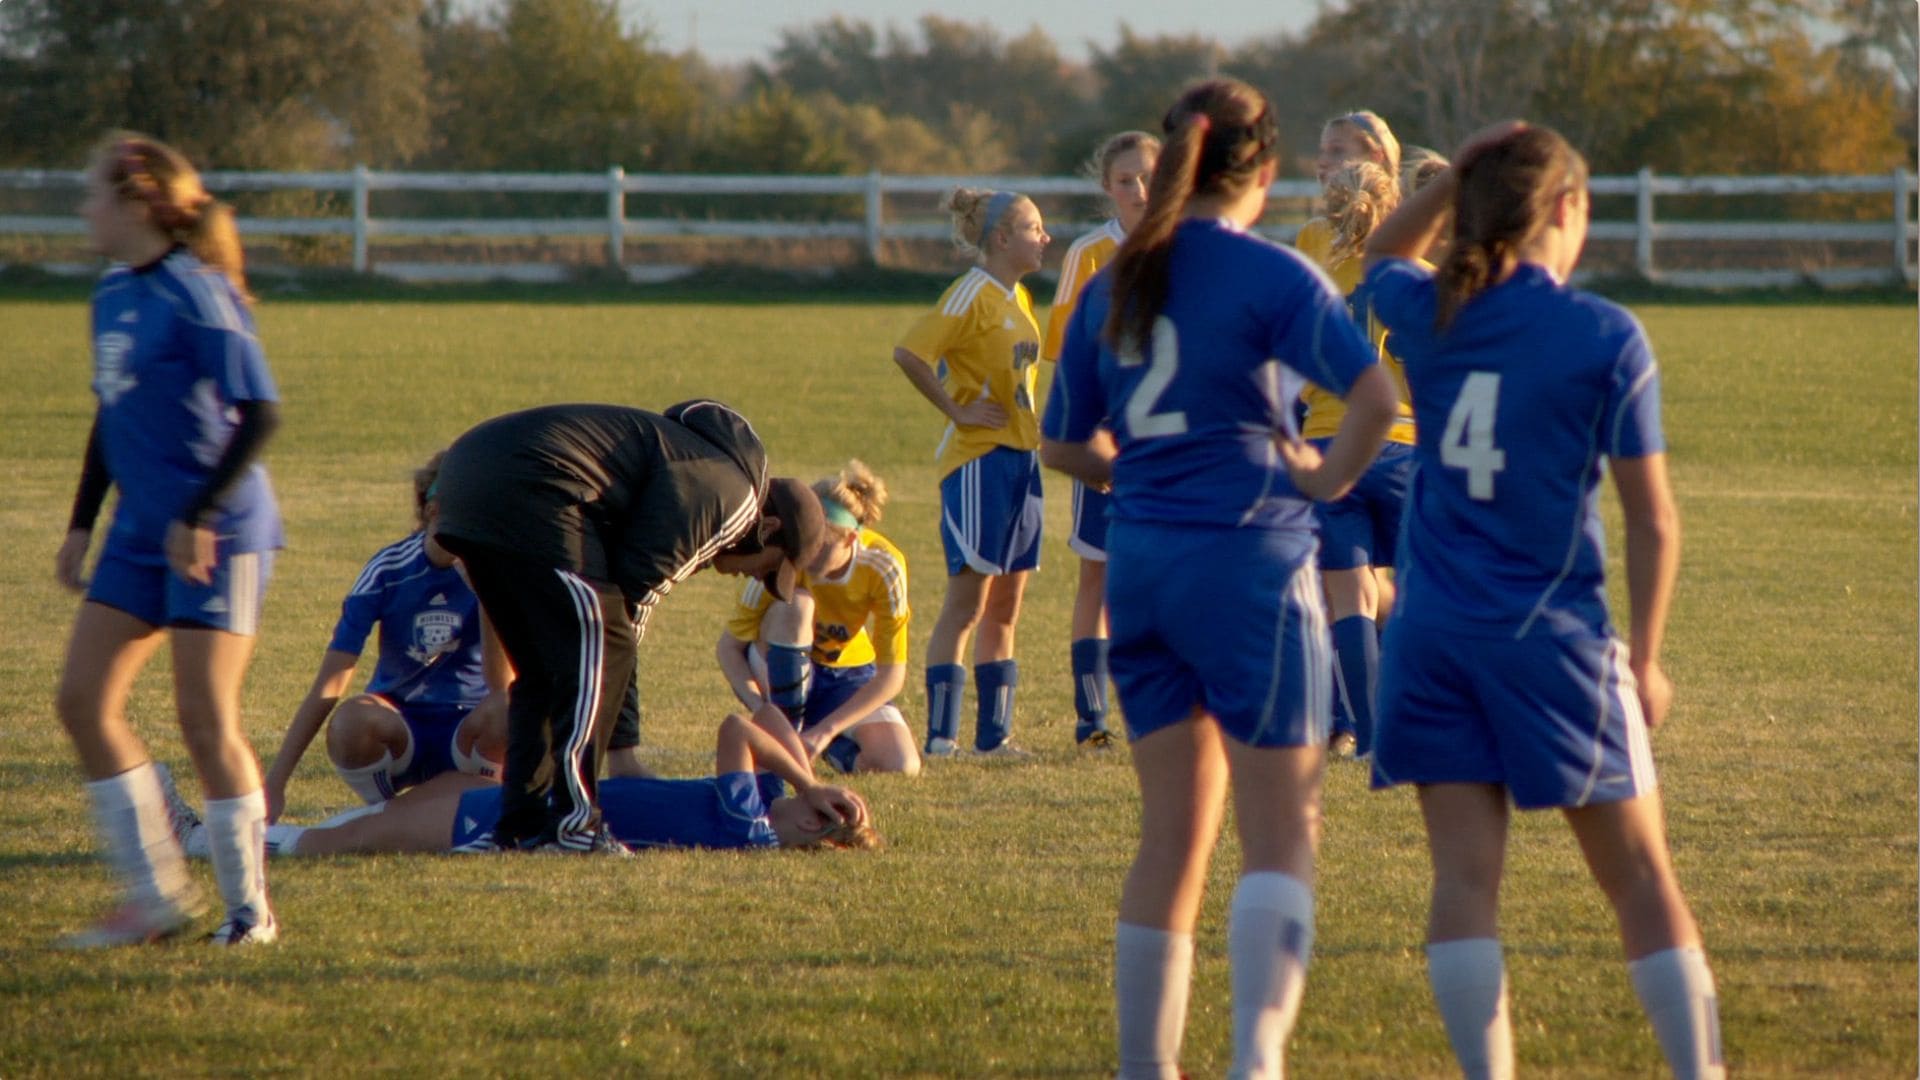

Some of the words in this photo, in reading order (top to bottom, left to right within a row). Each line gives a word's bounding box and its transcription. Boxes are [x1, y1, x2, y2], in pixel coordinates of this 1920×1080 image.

[1118, 314, 1188, 439] 2
[1440, 370, 1506, 501] 4
[418, 613, 457, 625] MIDWEST
